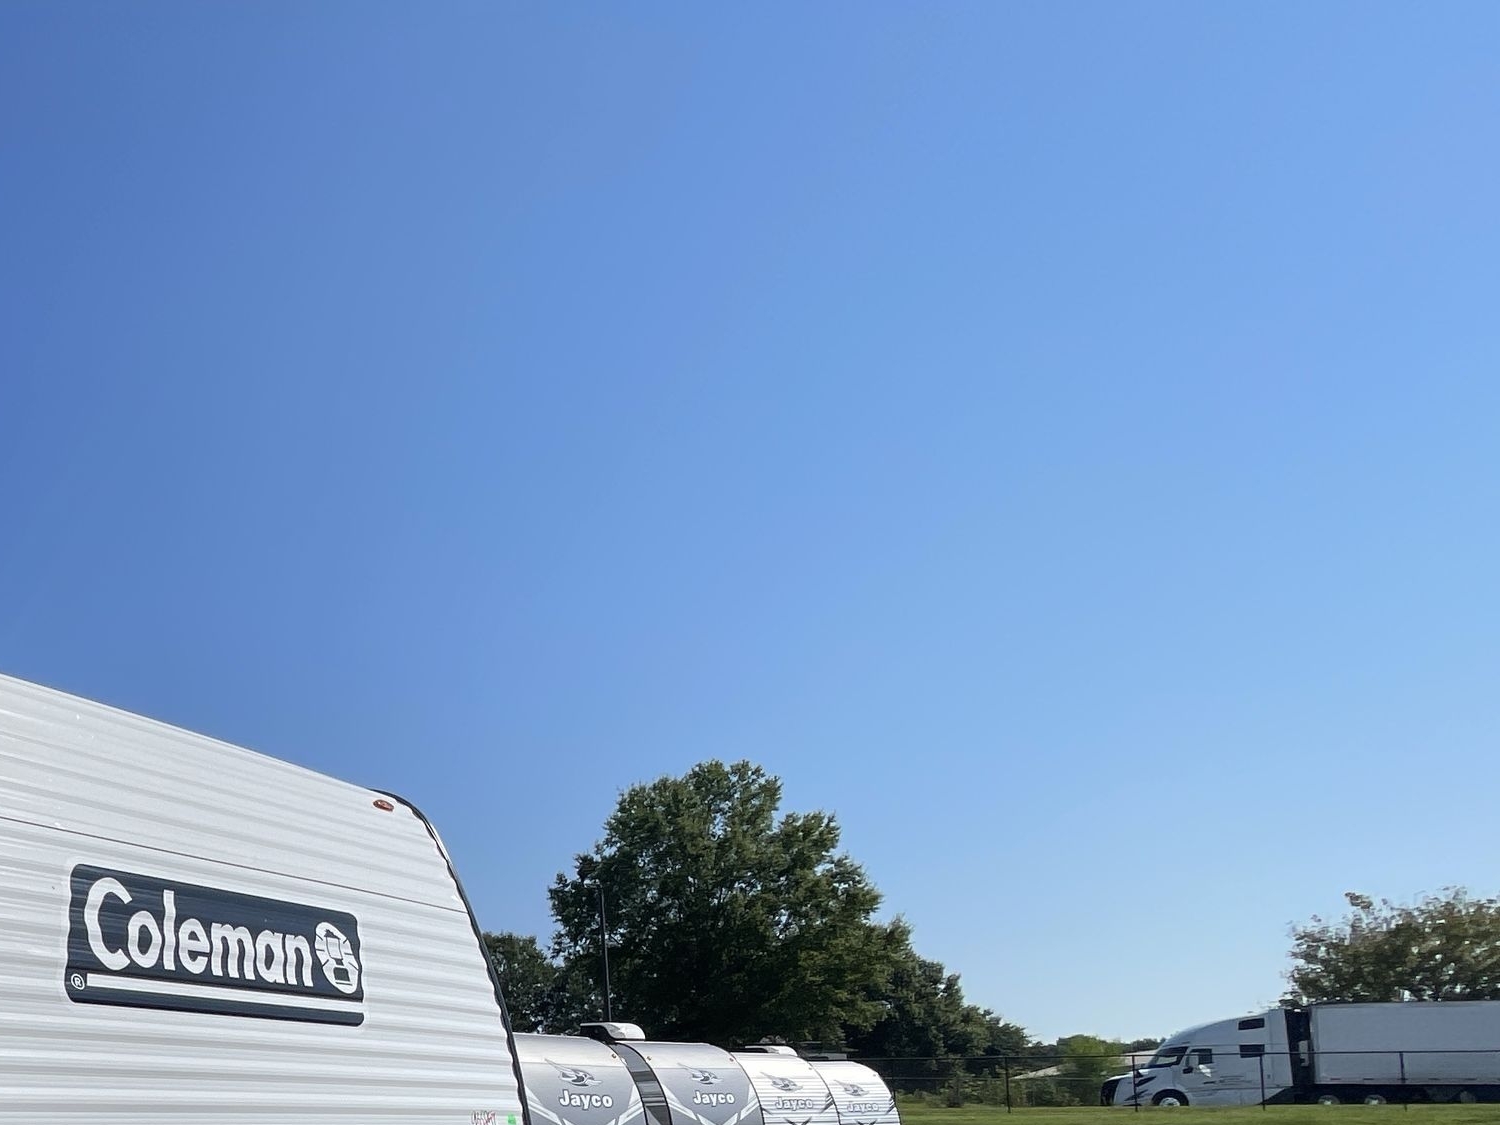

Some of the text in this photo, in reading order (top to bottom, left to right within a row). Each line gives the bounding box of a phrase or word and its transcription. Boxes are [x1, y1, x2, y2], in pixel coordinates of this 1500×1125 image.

[83, 877, 314, 987] Coleman
[559, 1090, 613, 1110] Jayco
[693, 1091, 735, 1106] Jayco
[775, 1096, 813, 1111] Jayco
[847, 1101, 880, 1114] Jayco
